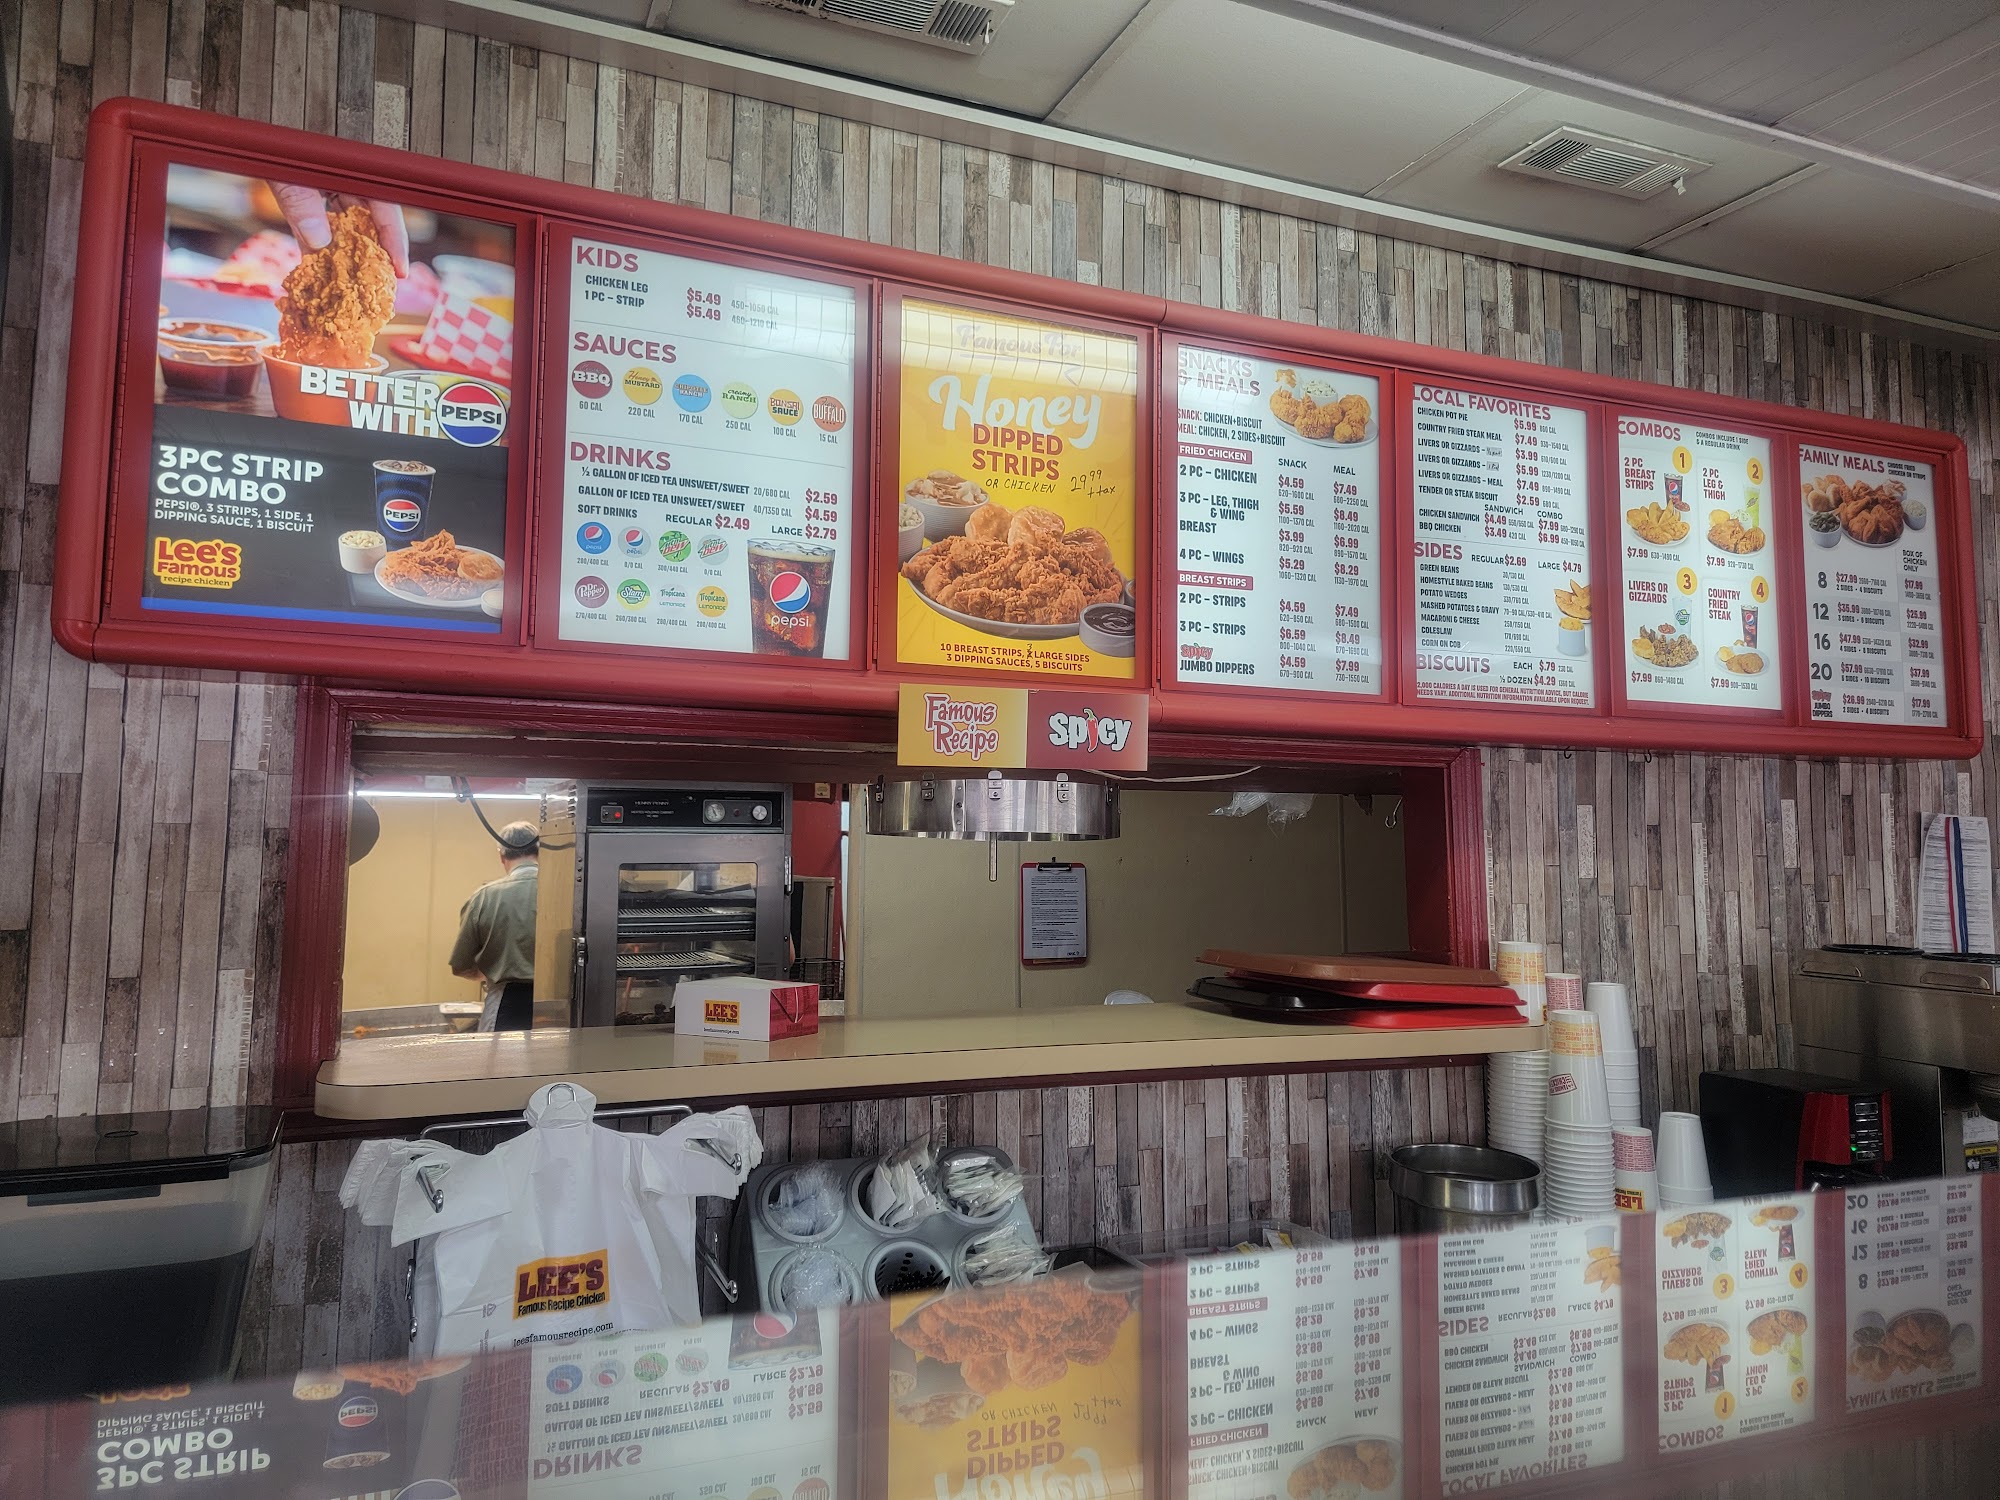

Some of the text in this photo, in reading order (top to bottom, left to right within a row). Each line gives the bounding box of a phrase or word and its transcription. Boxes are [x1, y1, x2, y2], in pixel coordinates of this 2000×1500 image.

[576, 245, 639, 273] KIDS
[586, 275, 648, 293] CHICKEN LEG
[616, 296, 644, 308] STRIP
[687, 288, 721, 306] $5.49
[686, 303, 721, 321] $5.49
[573, 332, 677, 363] SAUCES
[956, 324, 1082, 358] Famous For
[1178, 351, 1252, 377] SNACKS
[573, 370, 611, 387] BBQ
[625, 380, 660, 390] MUSTARD
[1197, 372, 1261, 396] MEALS
[301, 366, 440, 409] BETTER
[1413, 386, 1551, 421] LOCAL FAVORITES
[349, 401, 440, 438] WITH
[441, 405, 501, 425] PEPSI
[772, 407, 798, 417] SAUCE
[814, 406, 844, 424] BUFFALO
[928, 374, 1102, 450] Honey
[1418, 407, 1468, 421] CHICKEN POT PIE
[1204, 412, 1262, 429] CHICKEN+BISCUIT
[1514, 418, 1536, 431] $5.99
[1418, 423, 1502, 441] COUNTRY FRIED STEAK MEAL
[1618, 421, 1681, 441] COMBOS
[973, 424, 1063, 455] DIPPED
[1238, 431, 1285, 447] SIDES+BISCUIT
[1418, 438, 1440, 448] LIVERS
[1451, 443, 1480, 453] GIZZARDS
[570, 442, 671, 470] DRINKS
[1180, 446, 1247, 461] FRIED CHICKEN
[1516, 448, 1538, 461] $3.99
[1680, 453, 1685, 468] 1
[158, 445, 324, 482] 3PC STRIP
[972, 449, 1059, 480] STRIPS
[1279, 459, 1307, 469] SNACK
[1334, 466, 1355, 476] MEAL
[1843, 456, 1884, 473] MEALS
[1214, 469, 1257, 483] CHICKEN
[1625, 468, 1655, 479] BREAST
[1752, 464, 1759, 479] 2
[157, 471, 286, 505] COMBO
[592, 468, 750, 494] GALLON OF ICED TEA UNSWEET/SWEET
[986, 479, 1056, 494] OR CHICKEN
[1279, 475, 1304, 489] $4.59
[1334, 482, 1357, 495] $7.49
[1625, 479, 1653, 491] STRIPS
[805, 488, 838, 505] $2.59
[1419, 486, 1498, 501] TENDER BISCUIT
[1704, 489, 1725, 500] THIGH
[578, 504, 638, 518] SOFT DRINKS
[1232, 498, 1259, 510] THIGH
[1279, 502, 1304, 515] $5.59
[217, 505, 261, 518] STRIPS,
[274, 510, 304, 522] SIDE,
[386, 510, 419, 520] PEPSI
[805, 506, 837, 522] $4.59
[1220, 509, 1245, 520] WING
[1485, 504, 1562, 520] SANDWICH COMBO
[1485, 512, 1506, 525] $4.49
[155, 510, 314, 532] DIPPING SAUCE, BISCUIT
[665, 514, 750, 530] REGULAR $2.49
[1180, 520, 1216, 533] BREAST
[772, 524, 837, 540] LARGE $2.79
[1279, 529, 1304, 542] $3.99
[1334, 536, 1358, 549] $6.99
[1213, 551, 1244, 564] WINGS
[1415, 542, 1462, 560] SIDES
[1628, 546, 1648, 558] $7.99
[1279, 557, 1304, 570] $5.29
[1471, 554, 1526, 567] REGULAR $2.69
[1903, 558, 1927, 566] CHICKEN
[1420, 564, 1459, 573] GREEN BEANS
[164, 576, 230, 586] recipe chicken
[1180, 574, 1246, 587] BREAST STRIPS
[1629, 580, 1656, 592] LIVERS
[1683, 574, 1691, 589] 3
[1818, 572, 1827, 588] 8
[1836, 571, 1857, 583] $27.99
[700, 592, 725, 603] Tropicana
[1421, 589, 1467, 599] POTATO WEDGES
[1629, 592, 1667, 603] GIZZARDS
[1708, 588, 1740, 600] COUNTRY
[1709, 599, 1728, 609] FRIED
[1813, 603, 1829, 620] 12
[772, 616, 809, 628] pepsi
[1709, 610, 1731, 620] STEAK
[1421, 627, 1452, 636] COLESLAW
[1814, 632, 1861, 650] 16 $47.99
[940, 643, 1090, 662] 10 BREAST STRIPS, LARGE SIDES
[955, 655, 1083, 672] DIPPING SAUCES, BISCUITS
[1180, 660, 1254, 675] JUMBO DIPPERS
[1336, 659, 1359, 672] $7.99
[1417, 654, 1490, 673] BISCUITS
[1513, 661, 1555, 672] EACH $.79
[1811, 662, 1862, 680] 20 $57.99
[925, 693, 997, 730] Famous
[1812, 710, 1832, 718] DIPPERS
[1049, 709, 1132, 752] Spicy
[934, 722, 998, 760] Recipe
[706, 1003, 737, 1018] LEE'S
[518, 1259, 604, 1303] LEE'S
[518, 1292, 605, 1317] Famous Recipe Chicken
[513, 1322, 614, 1347] leesfamousrecipe.com
